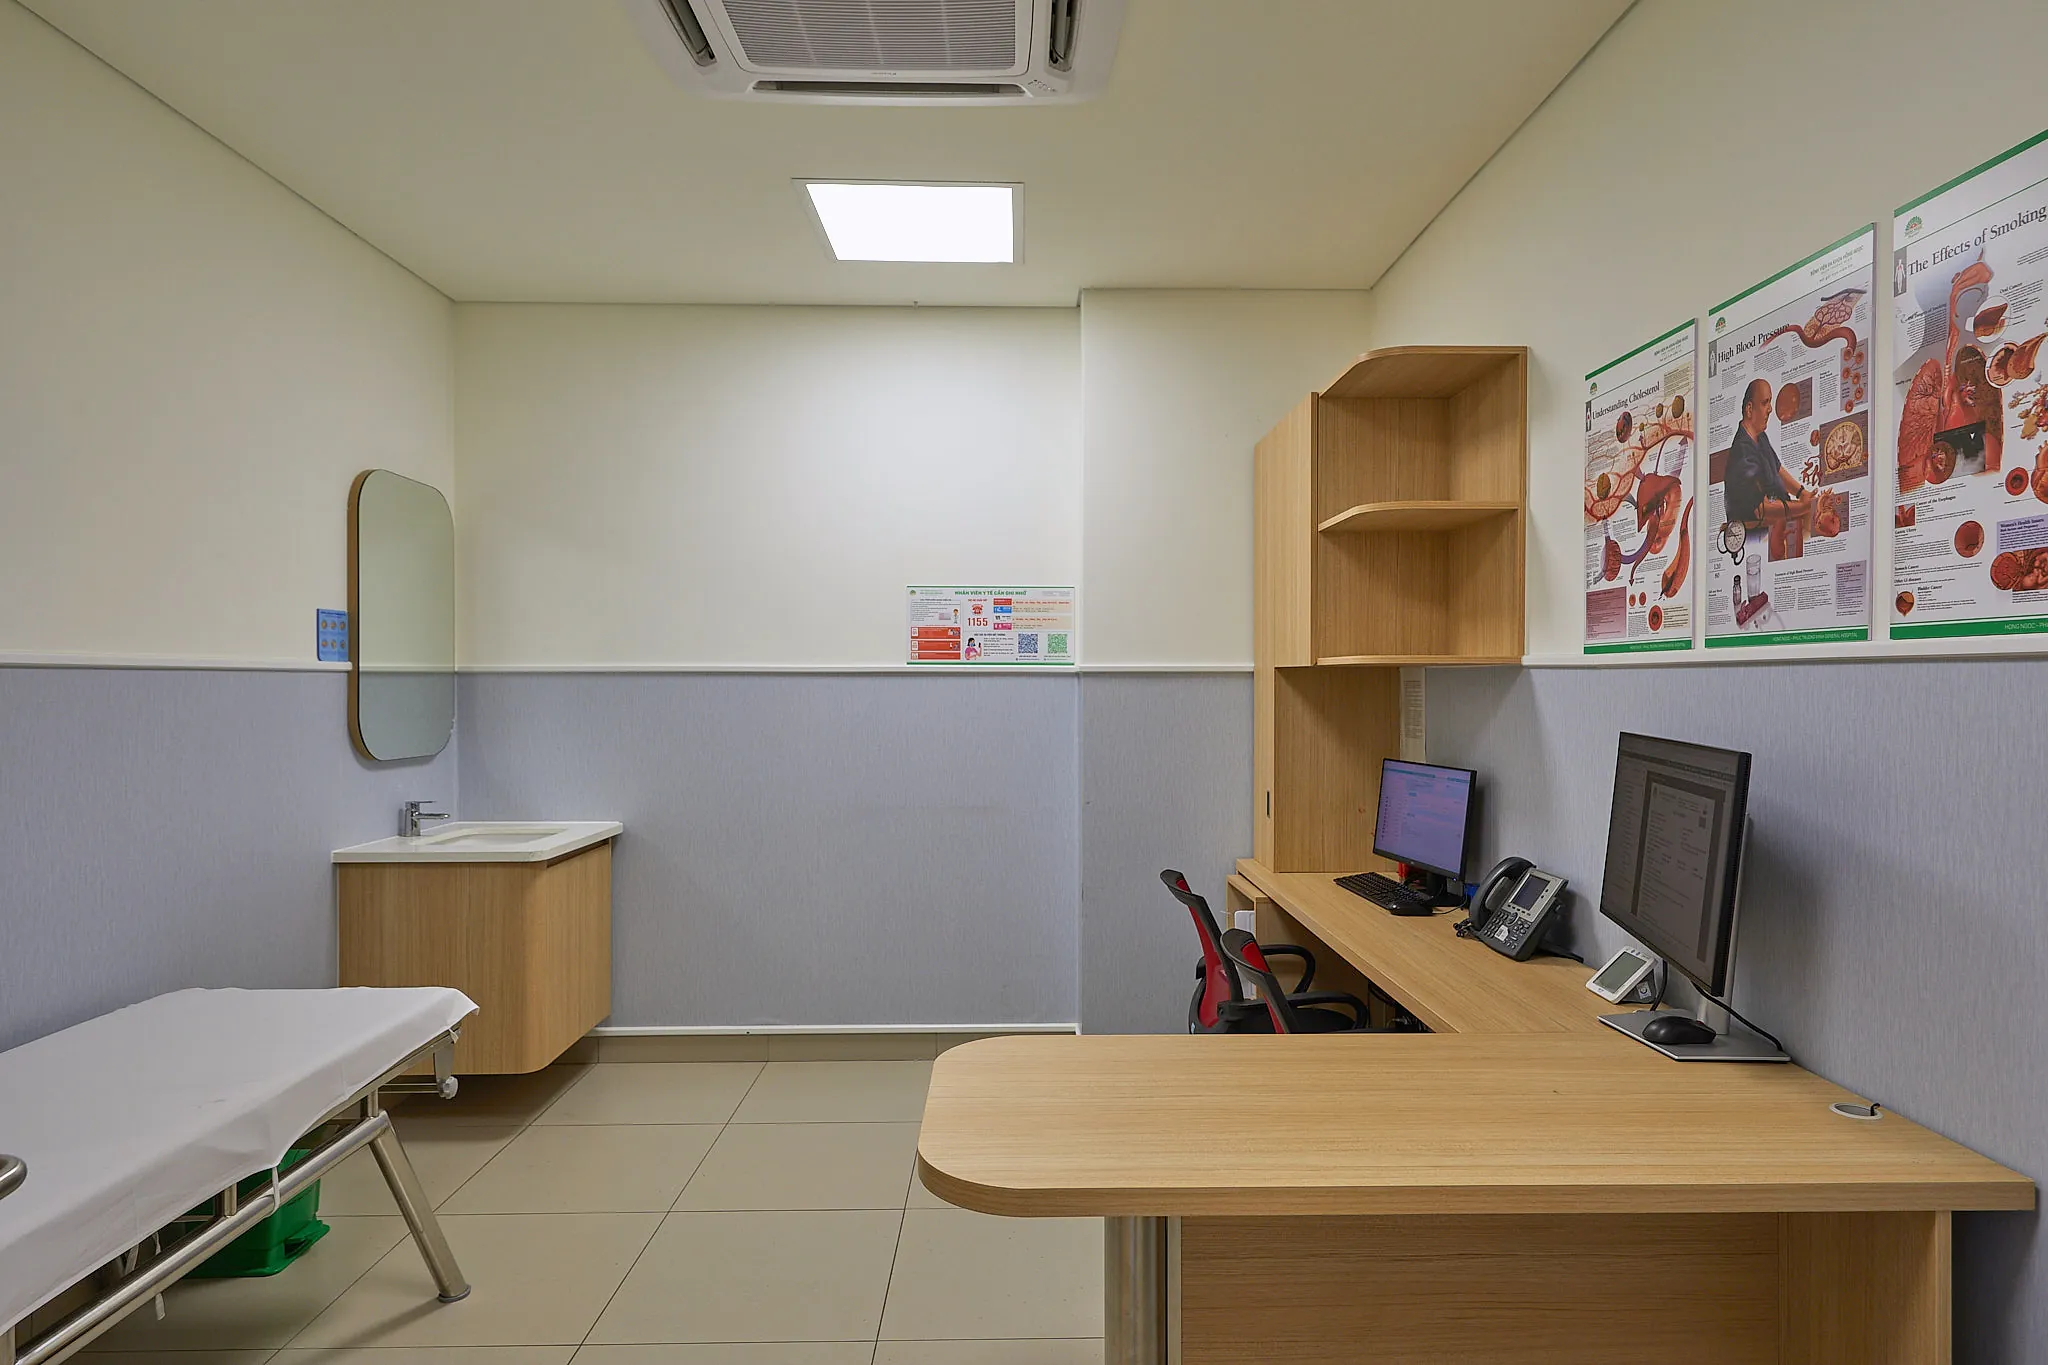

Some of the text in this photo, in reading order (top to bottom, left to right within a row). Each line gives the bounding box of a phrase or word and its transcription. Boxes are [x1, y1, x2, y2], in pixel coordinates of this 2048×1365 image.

[1908, 206, 2047, 276] The Effects of Smoking
[1718, 347, 1734, 363] High
[1736, 336, 1756, 354] Blood
[1758, 323, 1790, 344] Pressure
[1592, 381, 1660, 420] Understanding Cholesterol
[968, 617, 988, 627] 1155
